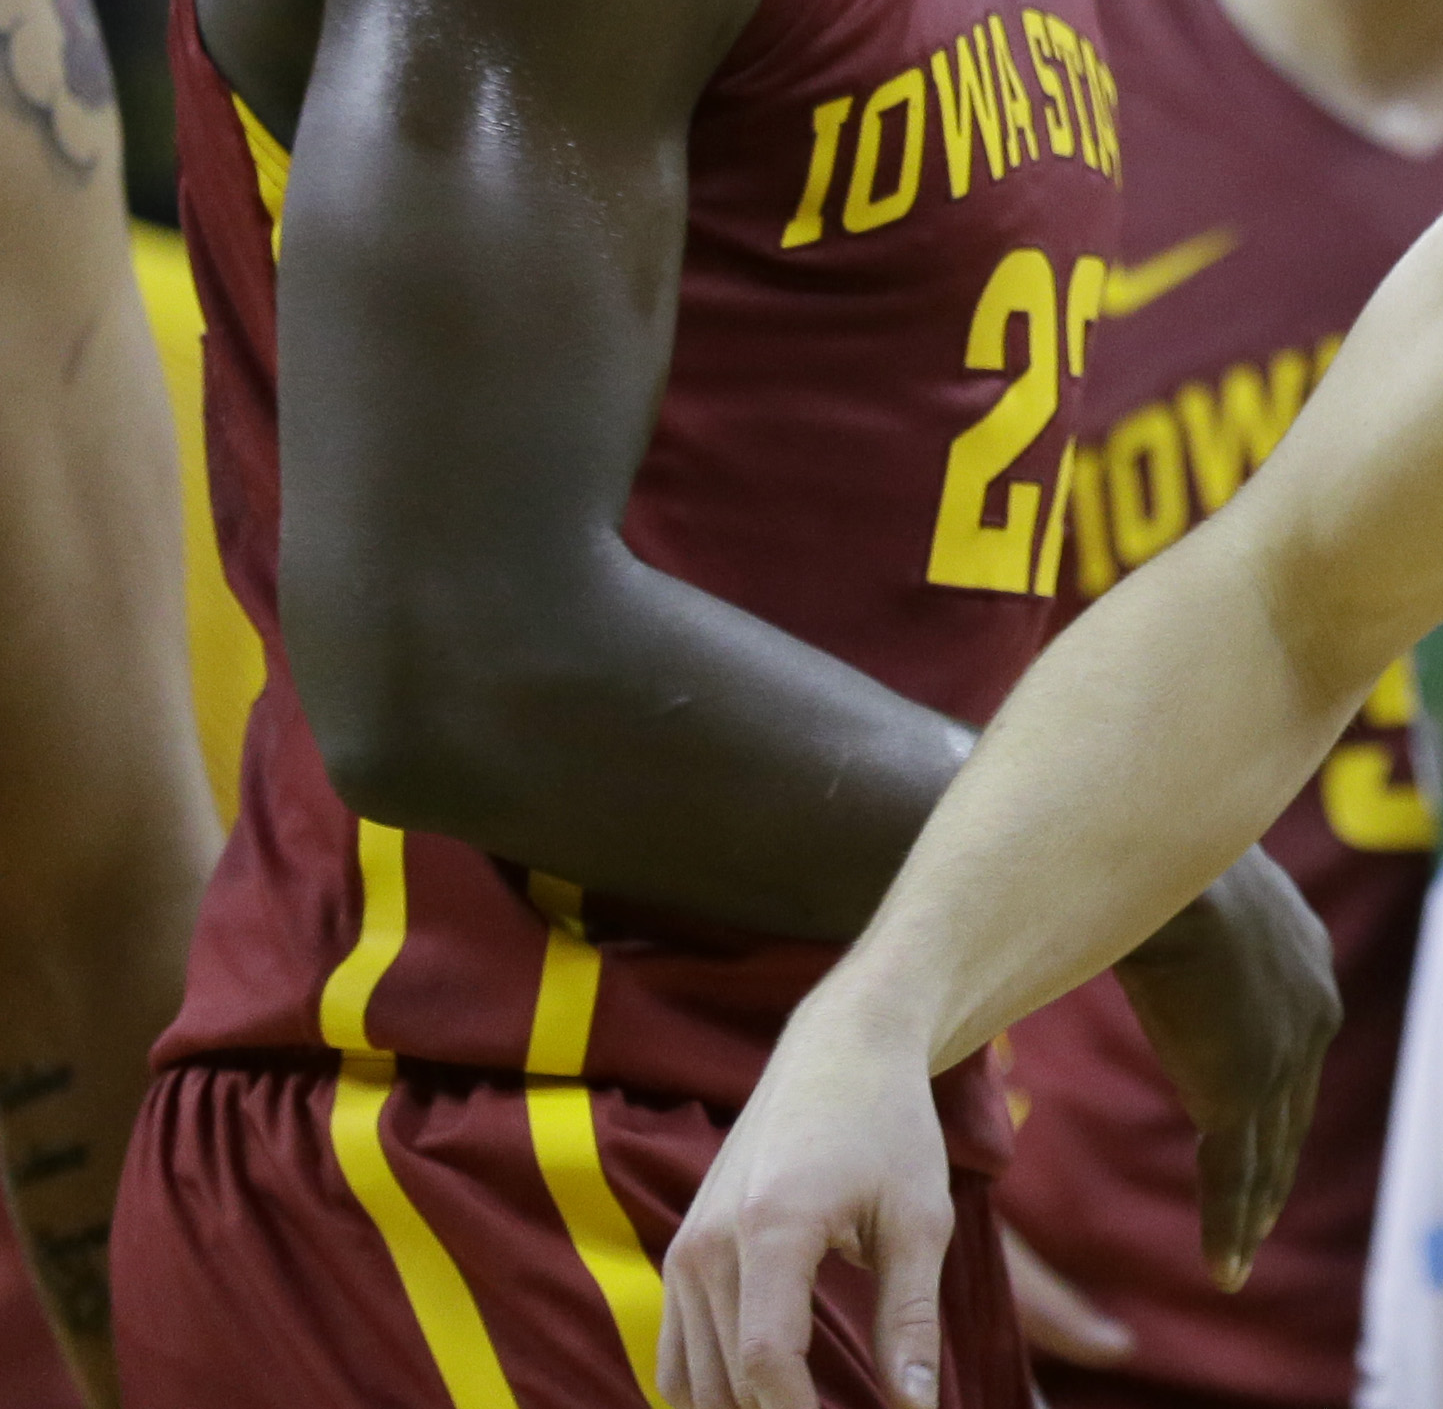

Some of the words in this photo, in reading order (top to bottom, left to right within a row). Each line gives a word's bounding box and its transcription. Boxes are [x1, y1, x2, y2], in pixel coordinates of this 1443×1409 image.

[780, 13, 1041, 249] IOWA
[1022, 7, 1123, 191] STA
[1072, 334, 1345, 597] IOW
